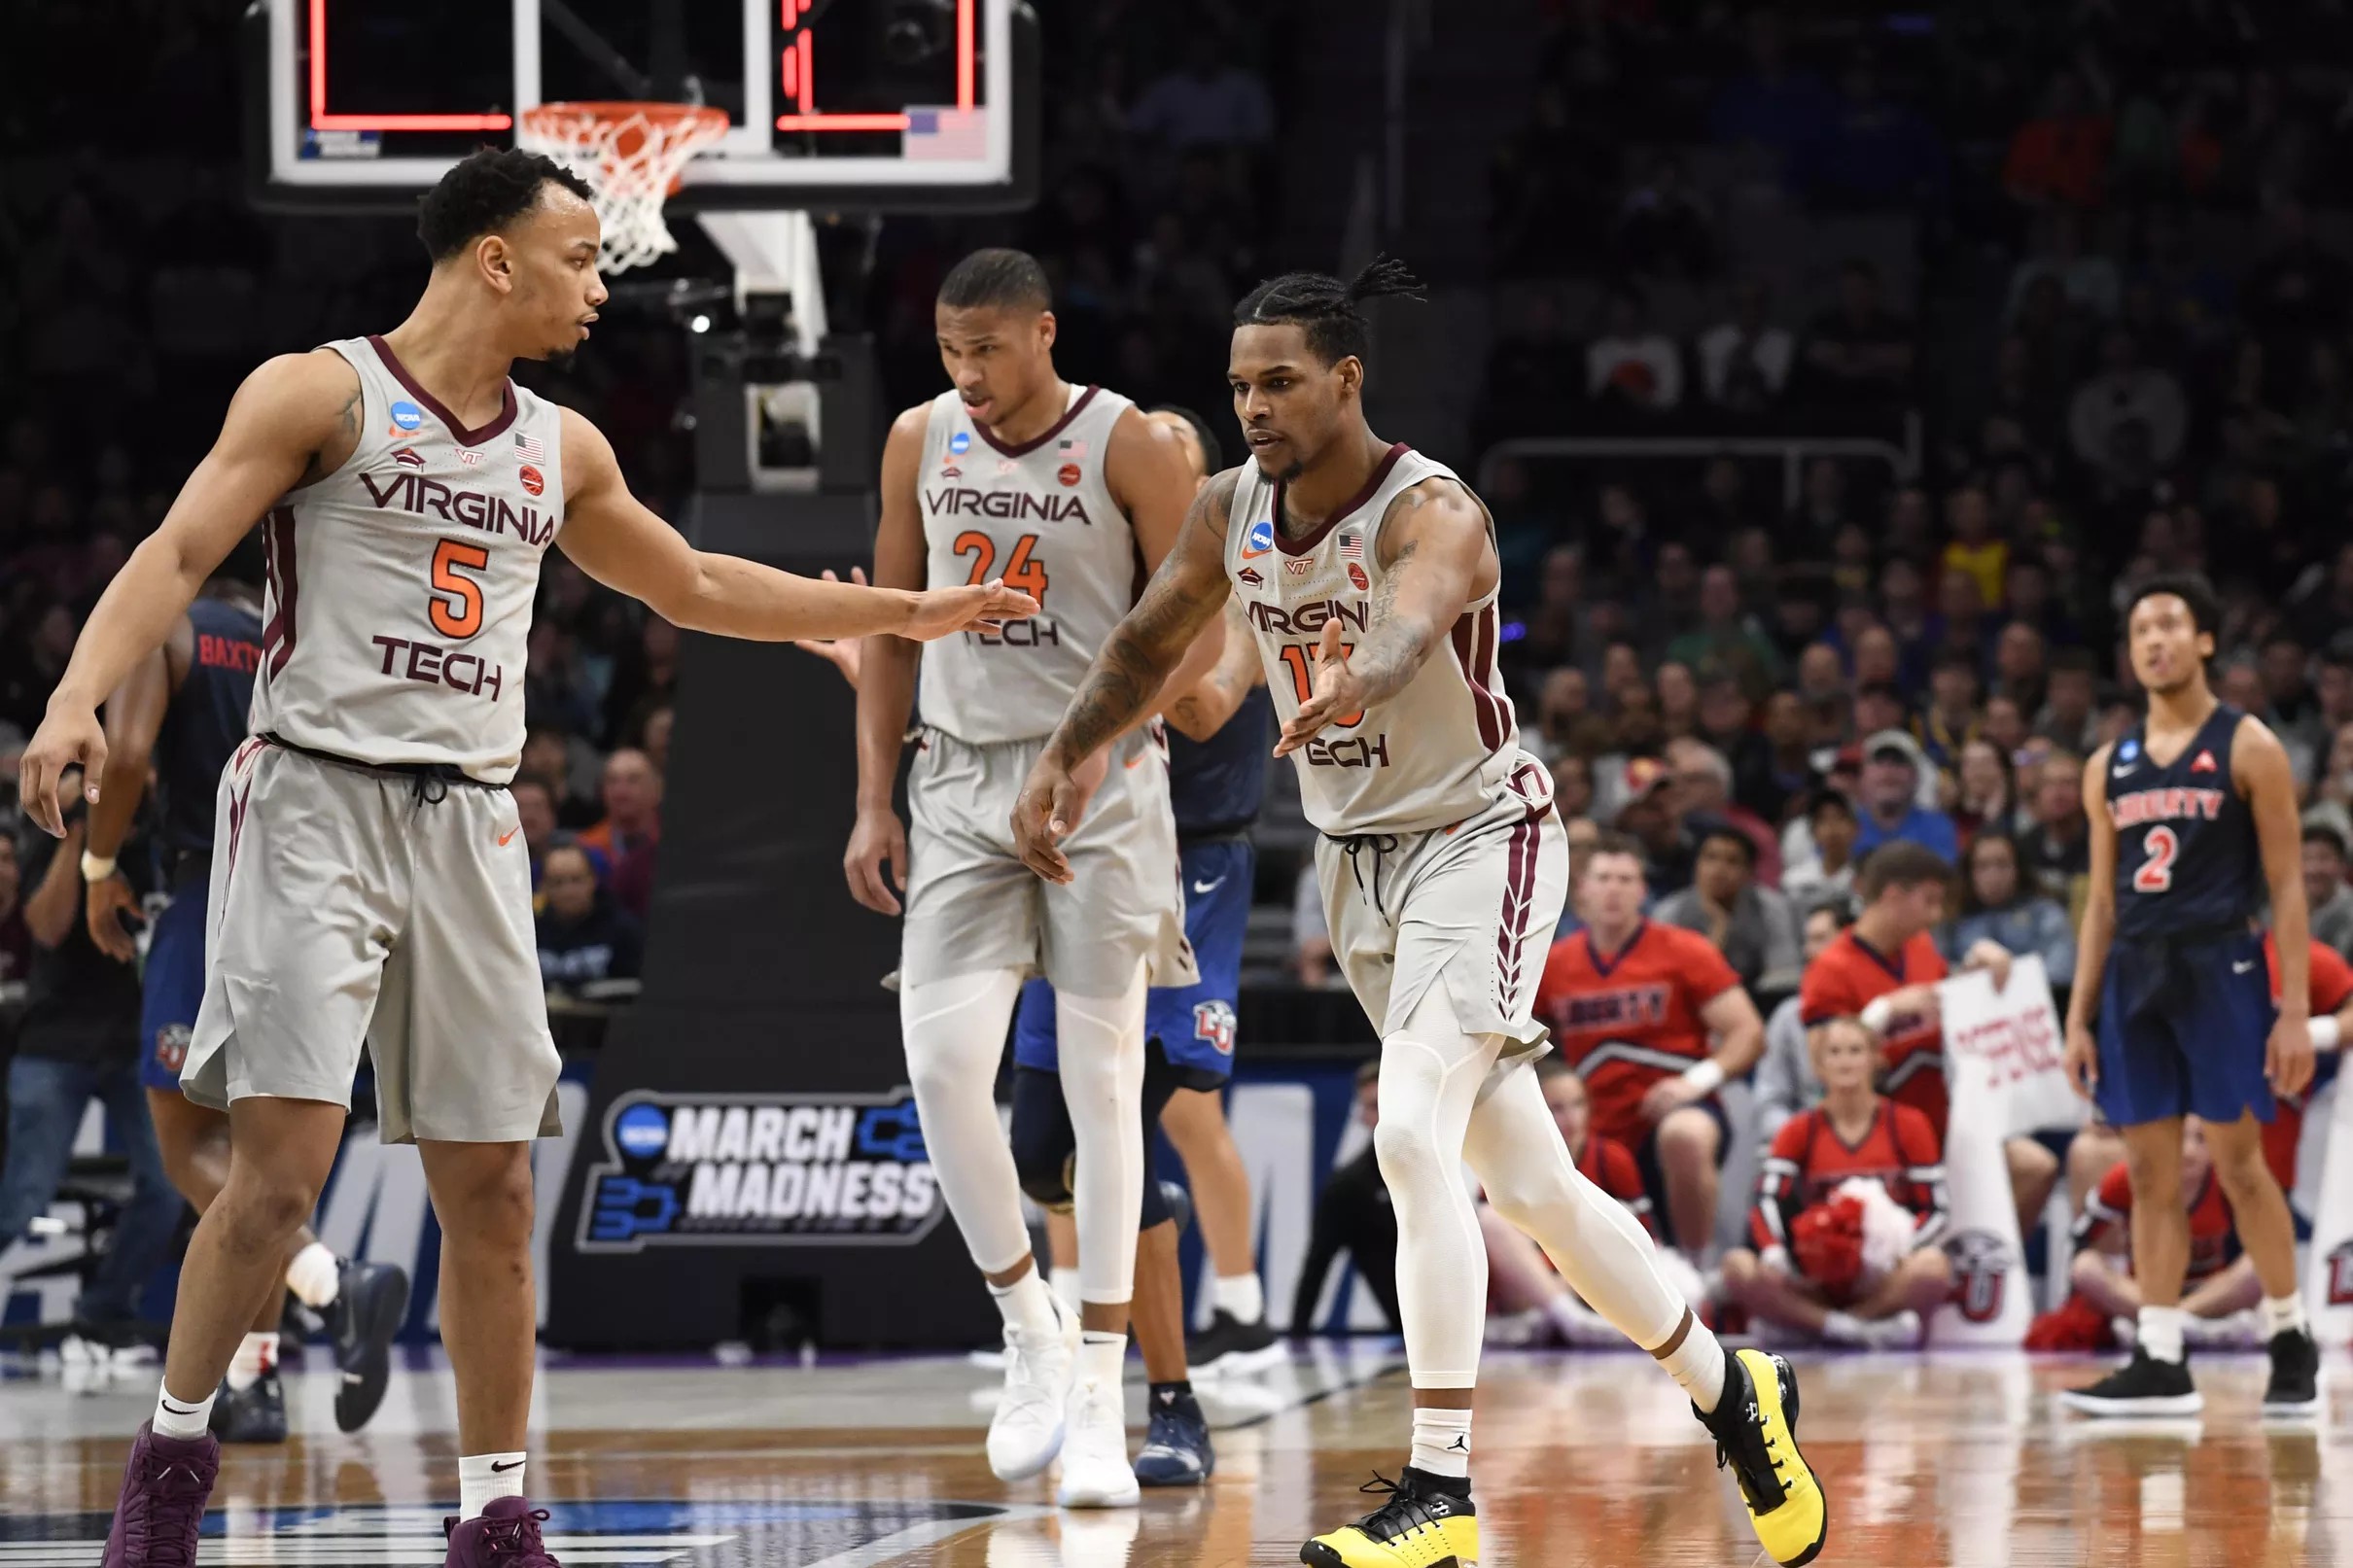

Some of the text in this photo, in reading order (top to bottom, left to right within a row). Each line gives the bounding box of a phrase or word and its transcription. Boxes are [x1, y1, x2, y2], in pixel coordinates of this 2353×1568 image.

[454, 447, 483, 466] VT
[926, 488, 1091, 525] VIRGINIA
[428, 538, 489, 639] 5
[953, 530, 1048, 612] 24
[1284, 558, 1314, 575] VT
[372, 635, 502, 702] TECH
[1305, 733, 1389, 768] ECH
[2134, 825, 2178, 891] 2
[667, 1106, 856, 1161] MARCH
[686, 1163, 935, 1219] MADNESS
